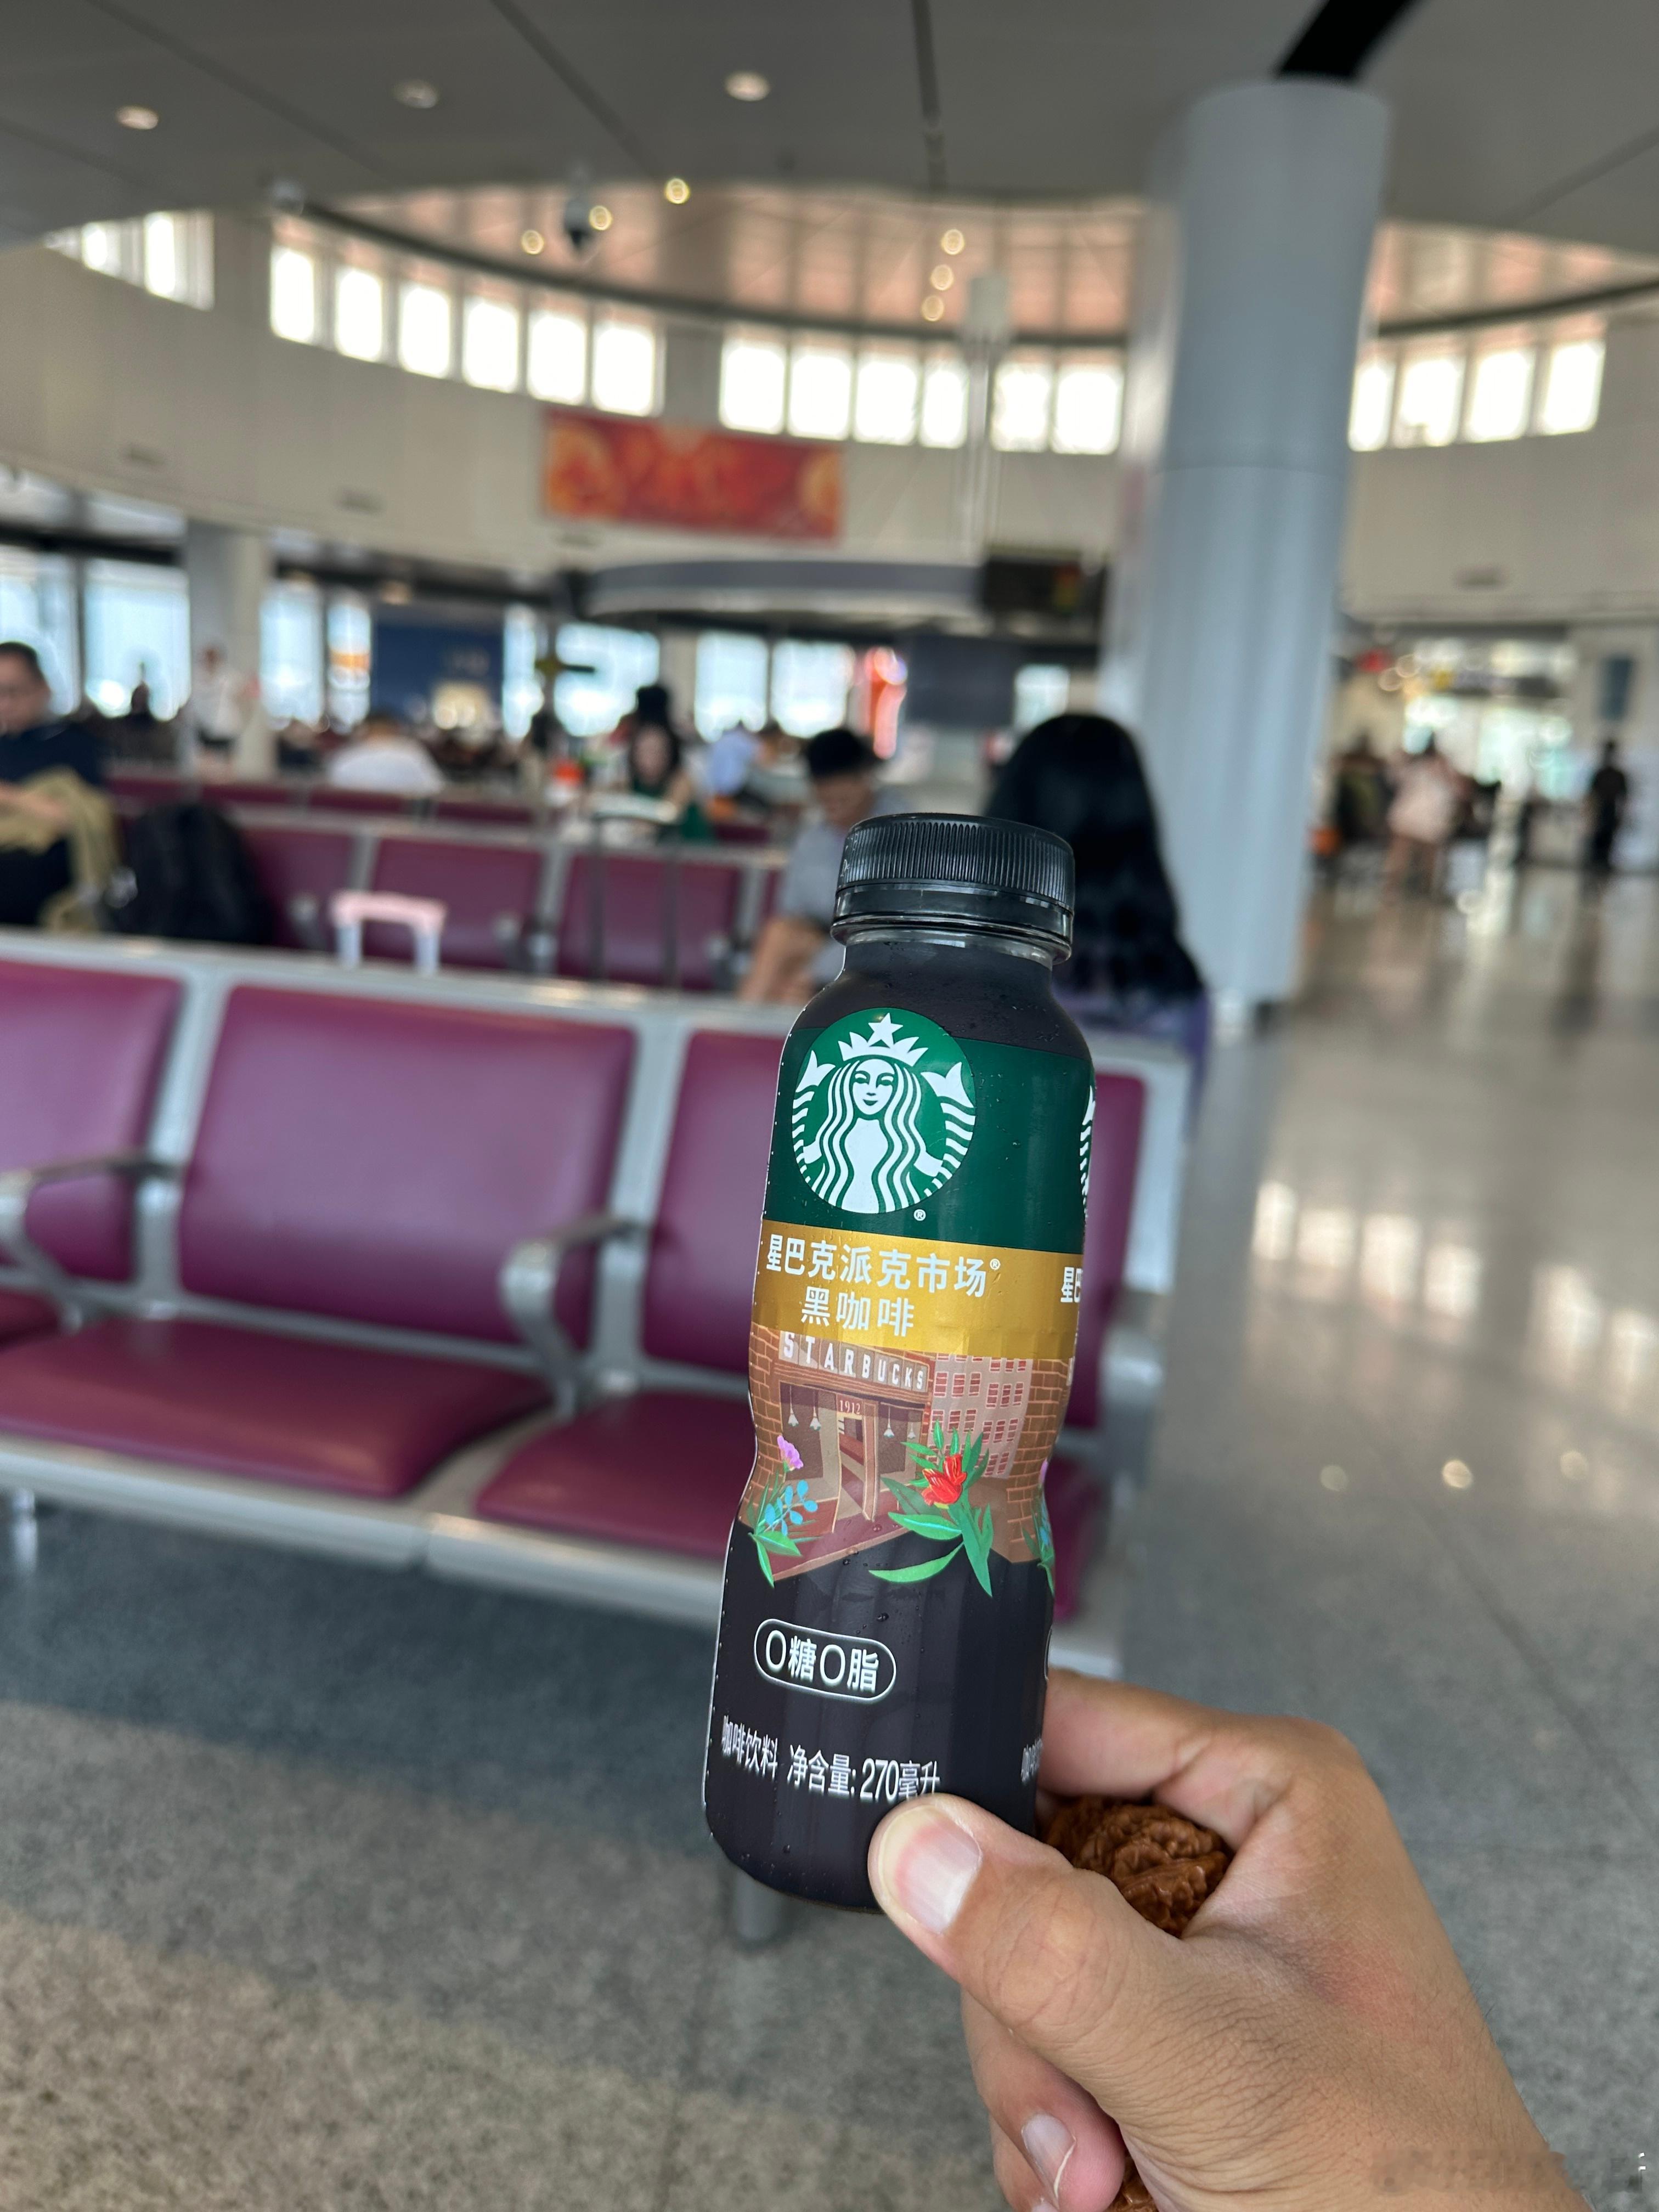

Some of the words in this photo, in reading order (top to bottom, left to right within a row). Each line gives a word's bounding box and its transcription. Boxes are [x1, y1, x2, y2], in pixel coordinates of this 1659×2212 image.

[801, 1285, 915, 1338] 黑咖啡
[783, 1331, 923, 1390] STARBUCKS
[839, 1400, 861, 1415] 1912
[721, 1714, 778, 1780] 咖啡饮料
